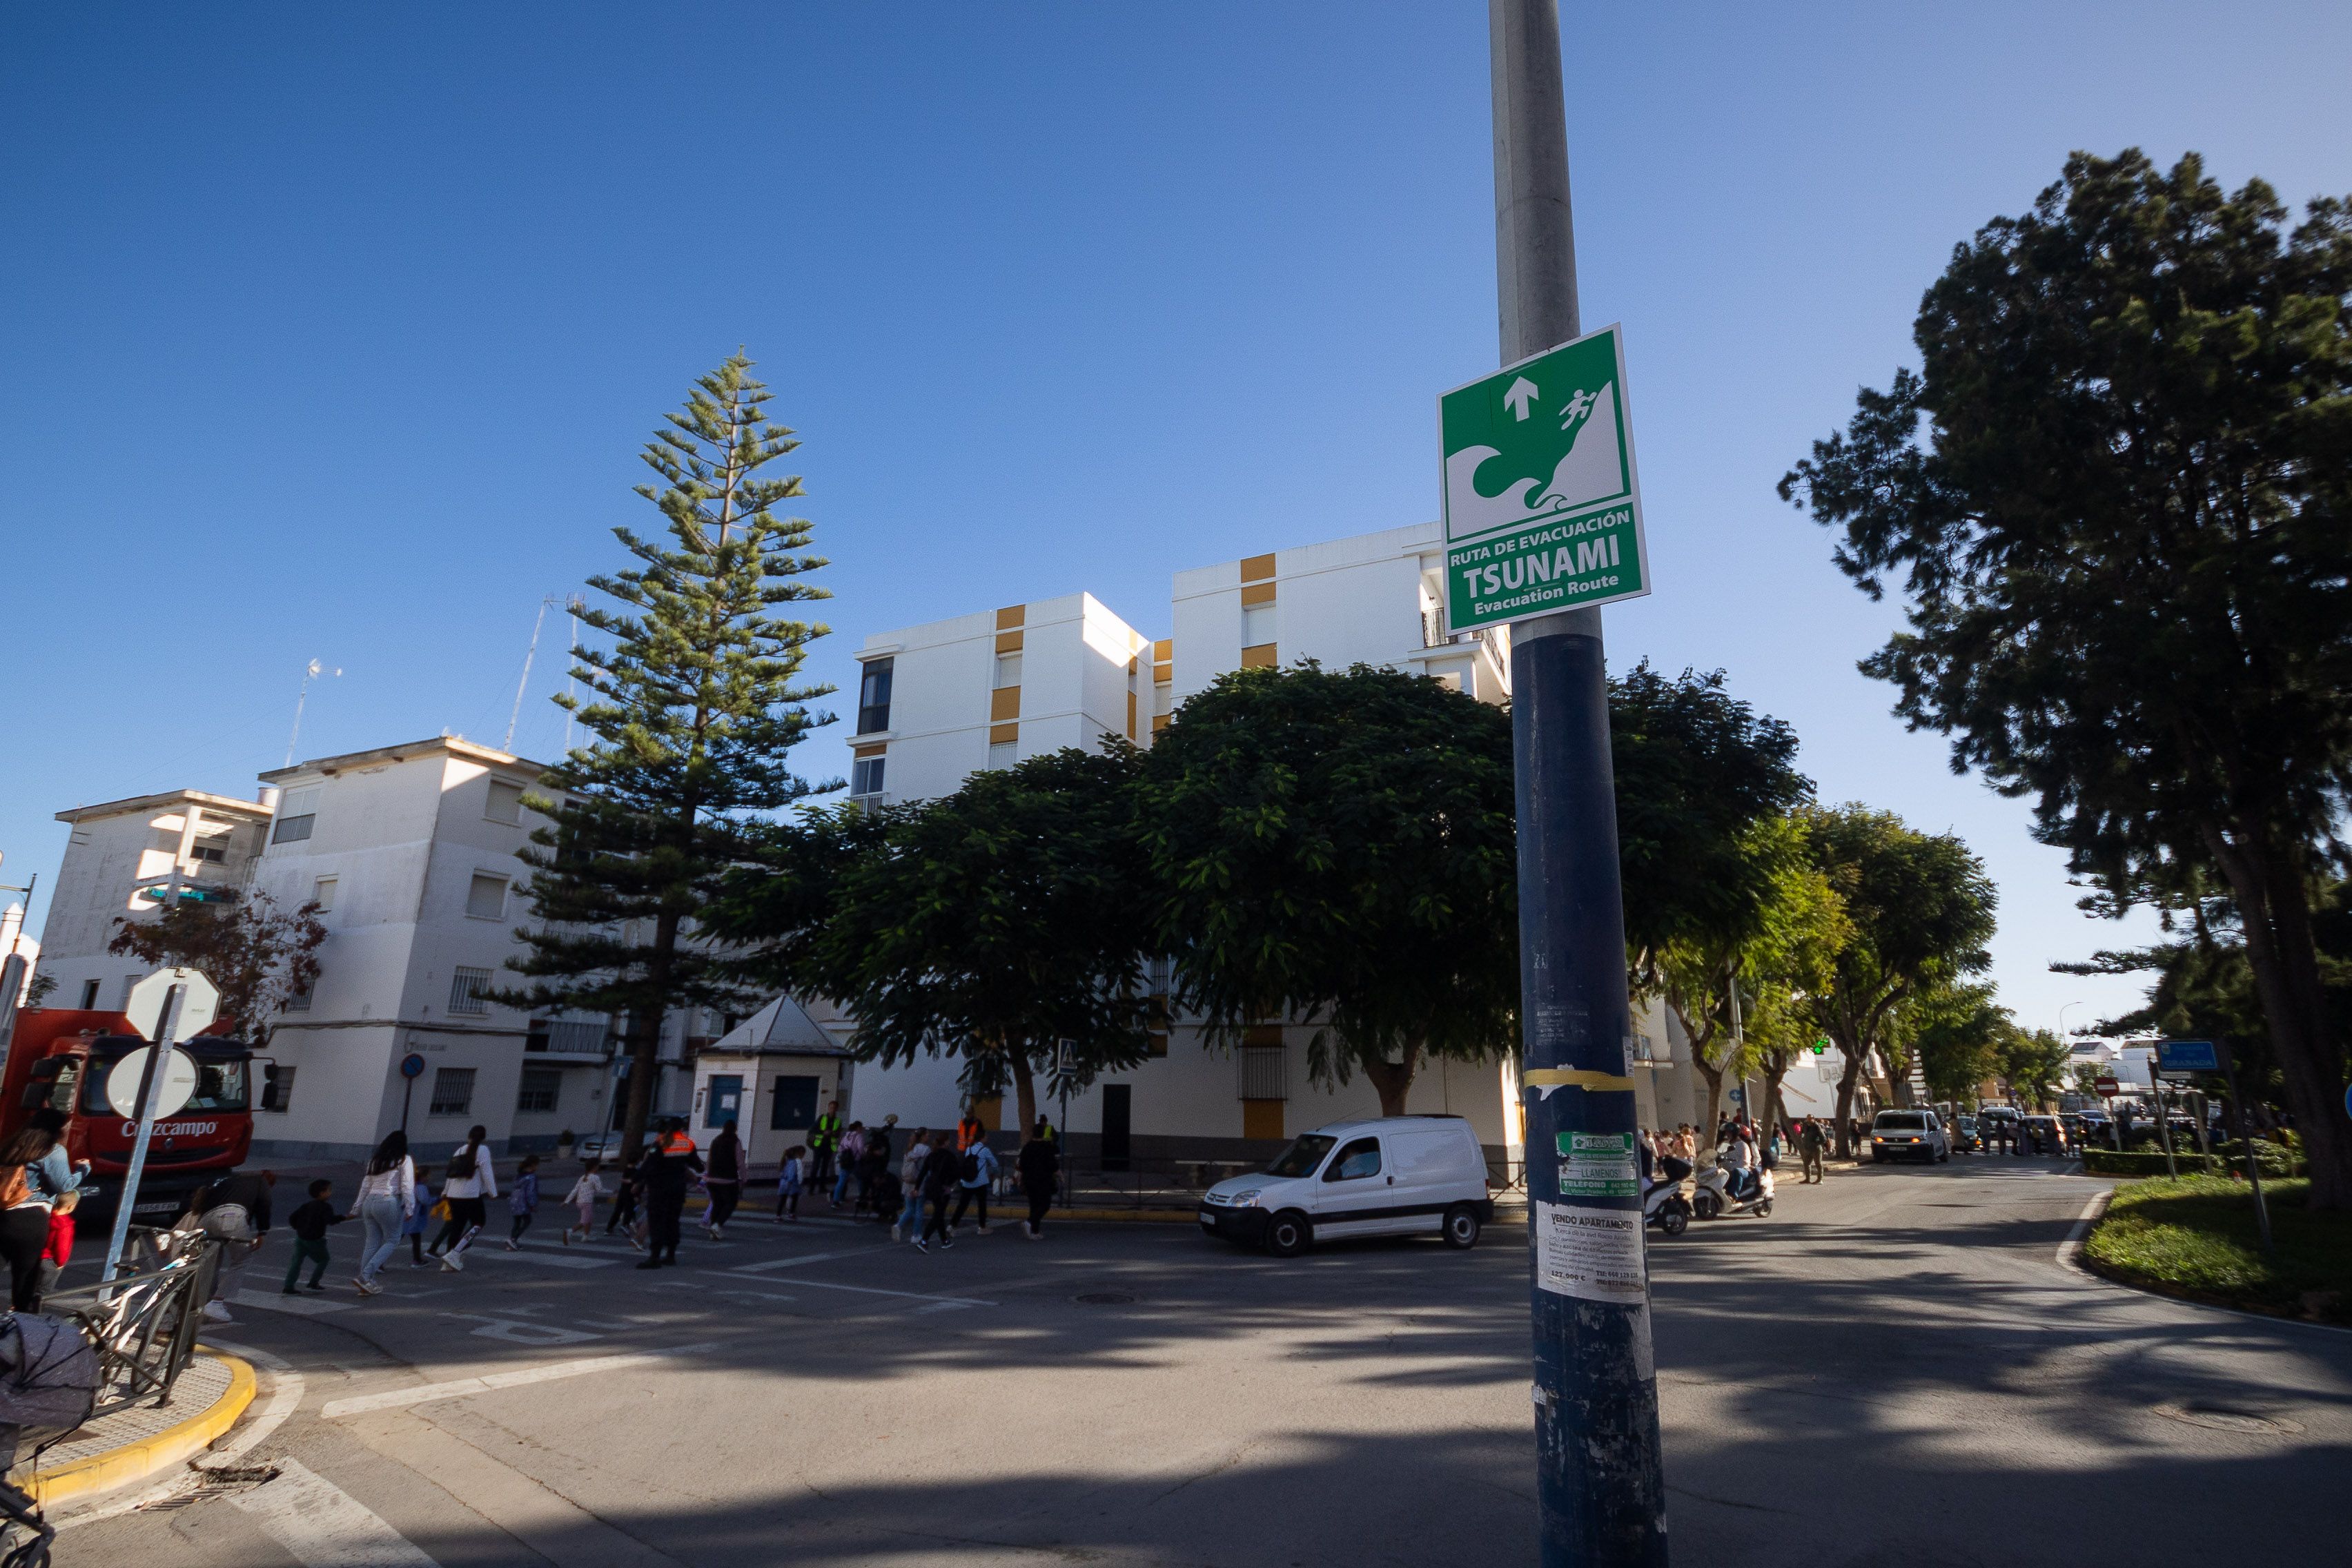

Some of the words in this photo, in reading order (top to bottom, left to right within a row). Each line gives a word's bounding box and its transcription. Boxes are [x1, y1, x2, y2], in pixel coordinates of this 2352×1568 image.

[1451, 547, 1491, 567] RUTA
[1495, 540, 1516, 556] DE
[1519, 510, 1630, 550] EVACUACIÓN
[1463, 534, 1620, 599] TSUNAMI
[1475, 587, 1564, 615] Evacuation
[1567, 574, 1619, 596] Route
[1551, 1213, 1577, 1225] VENDO
[1579, 1217, 1634, 1230] APARTAMENTO
